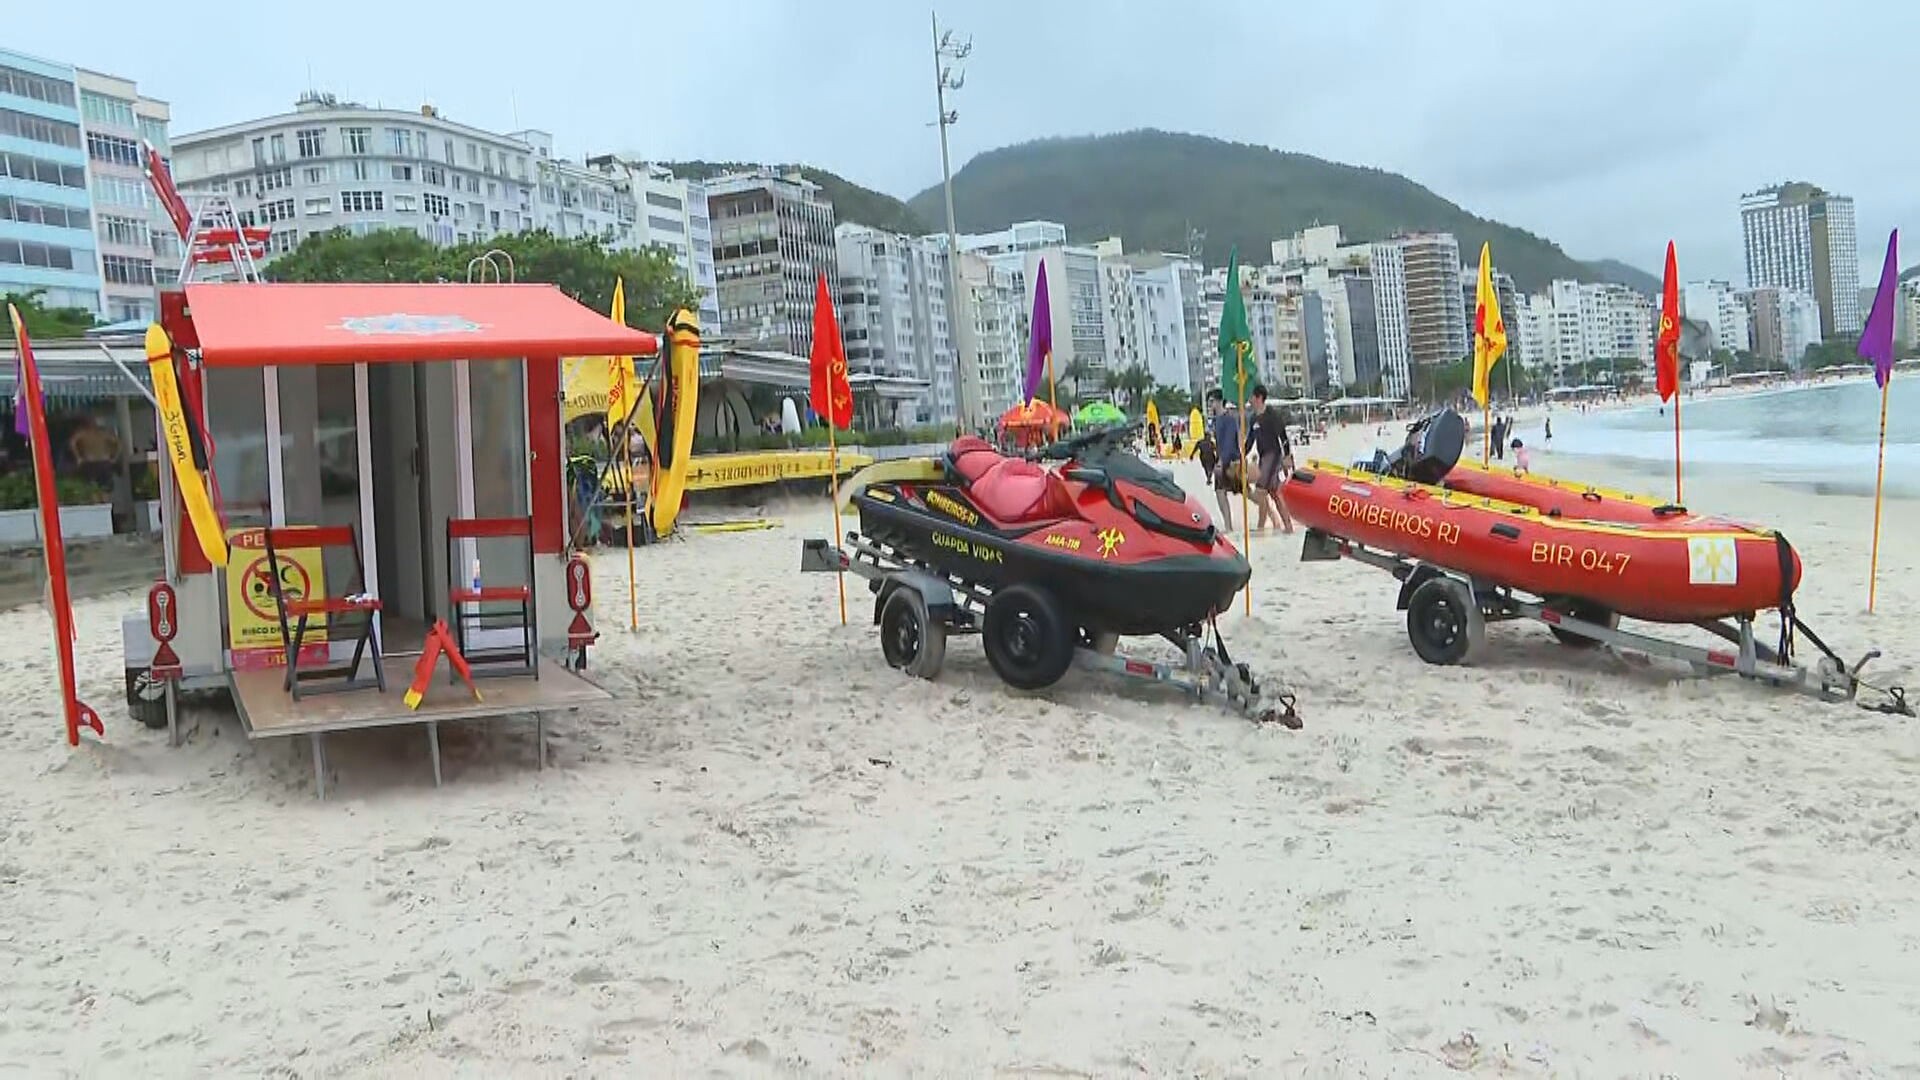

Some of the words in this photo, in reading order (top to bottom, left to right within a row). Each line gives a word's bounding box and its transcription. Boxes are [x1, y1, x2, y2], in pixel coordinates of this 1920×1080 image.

[1327, 494, 1434, 537] BOMBEIROS
[1437, 521, 1461, 545] RJ
[931, 531, 969, 554] GUARDA
[972, 543, 1003, 564] VIDAS
[1044, 534, 1081, 550] AMA-118
[1531, 541, 1574, 568] BIR
[1580, 548, 1632, 576] 047
